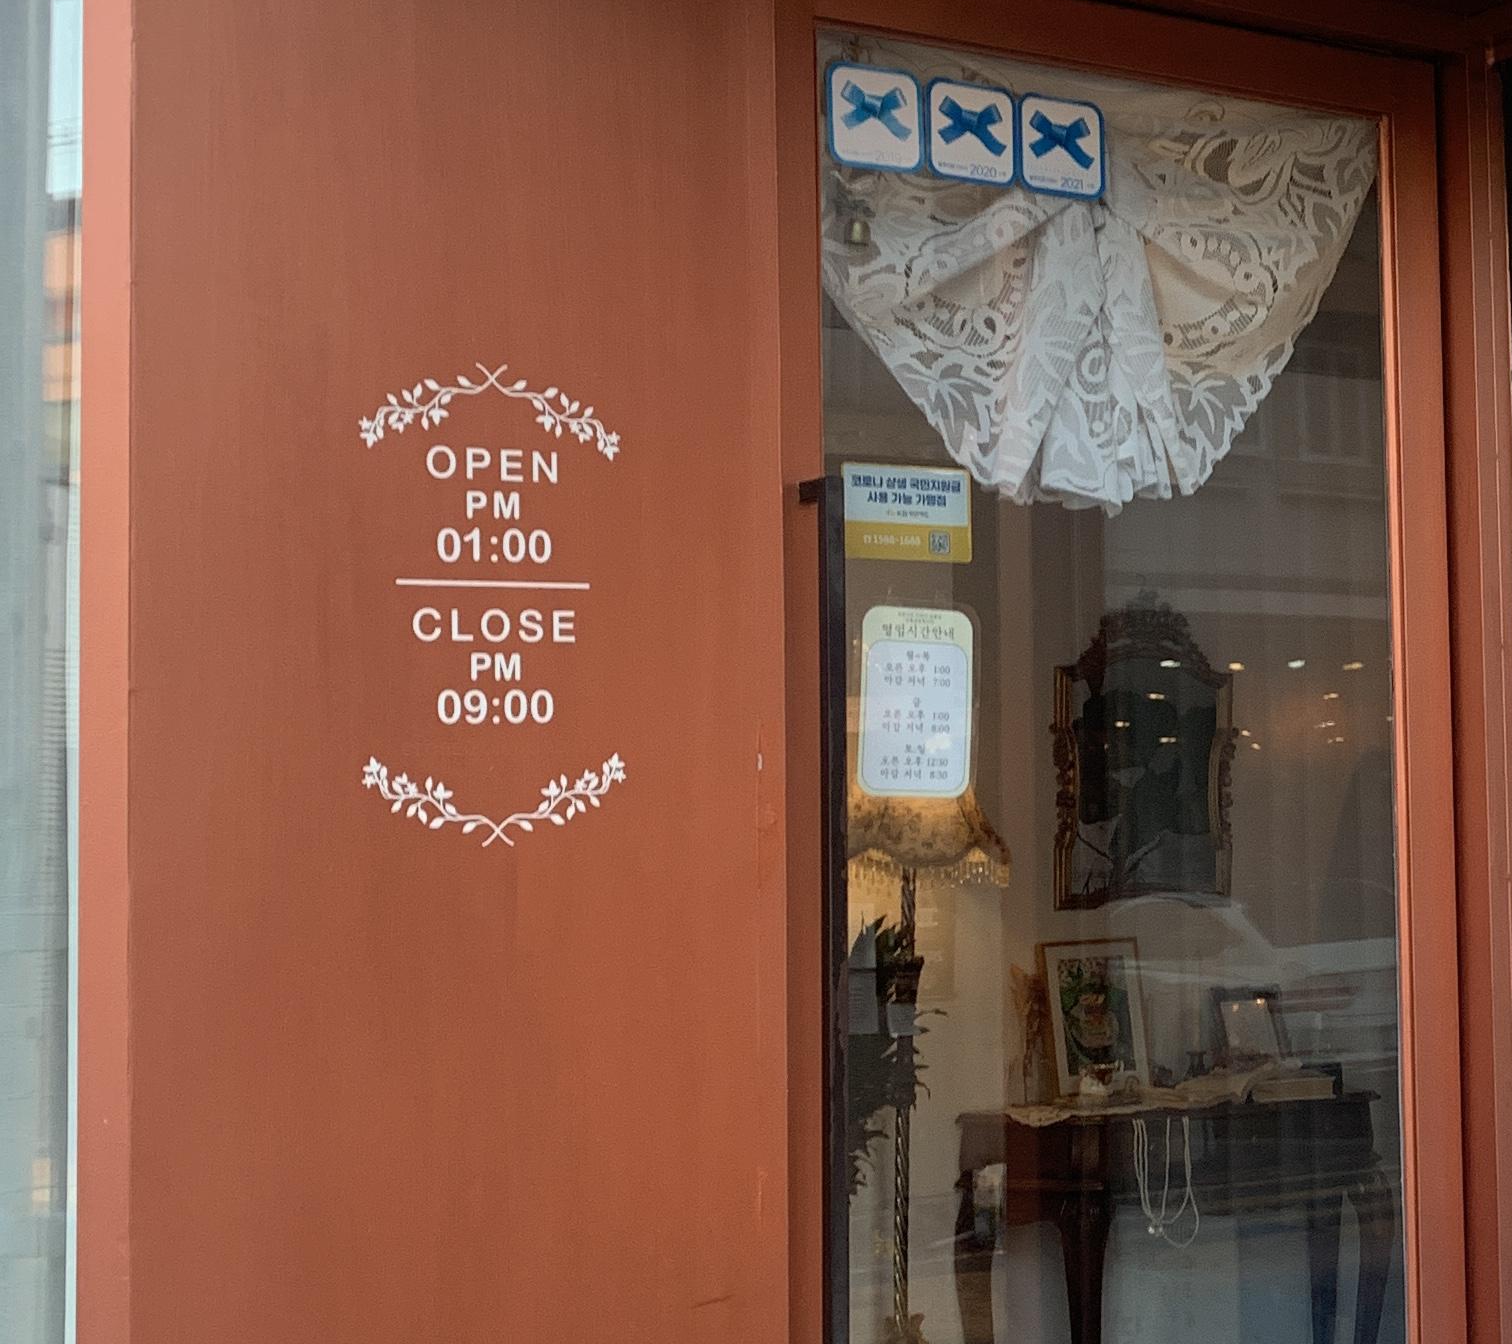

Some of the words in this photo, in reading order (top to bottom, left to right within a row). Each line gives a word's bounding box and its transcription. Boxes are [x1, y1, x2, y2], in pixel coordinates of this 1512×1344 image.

[970, 163, 998, 178] 2020
[1060, 176, 1084, 191] 2021
[425, 445, 558, 484] OPEN
[466, 491, 520, 520] PM
[436, 527, 553, 564] 01:00
[412, 607, 576, 644] CLOSE
[470, 652, 521, 681] PM
[436, 689, 554, 725] 09:00
